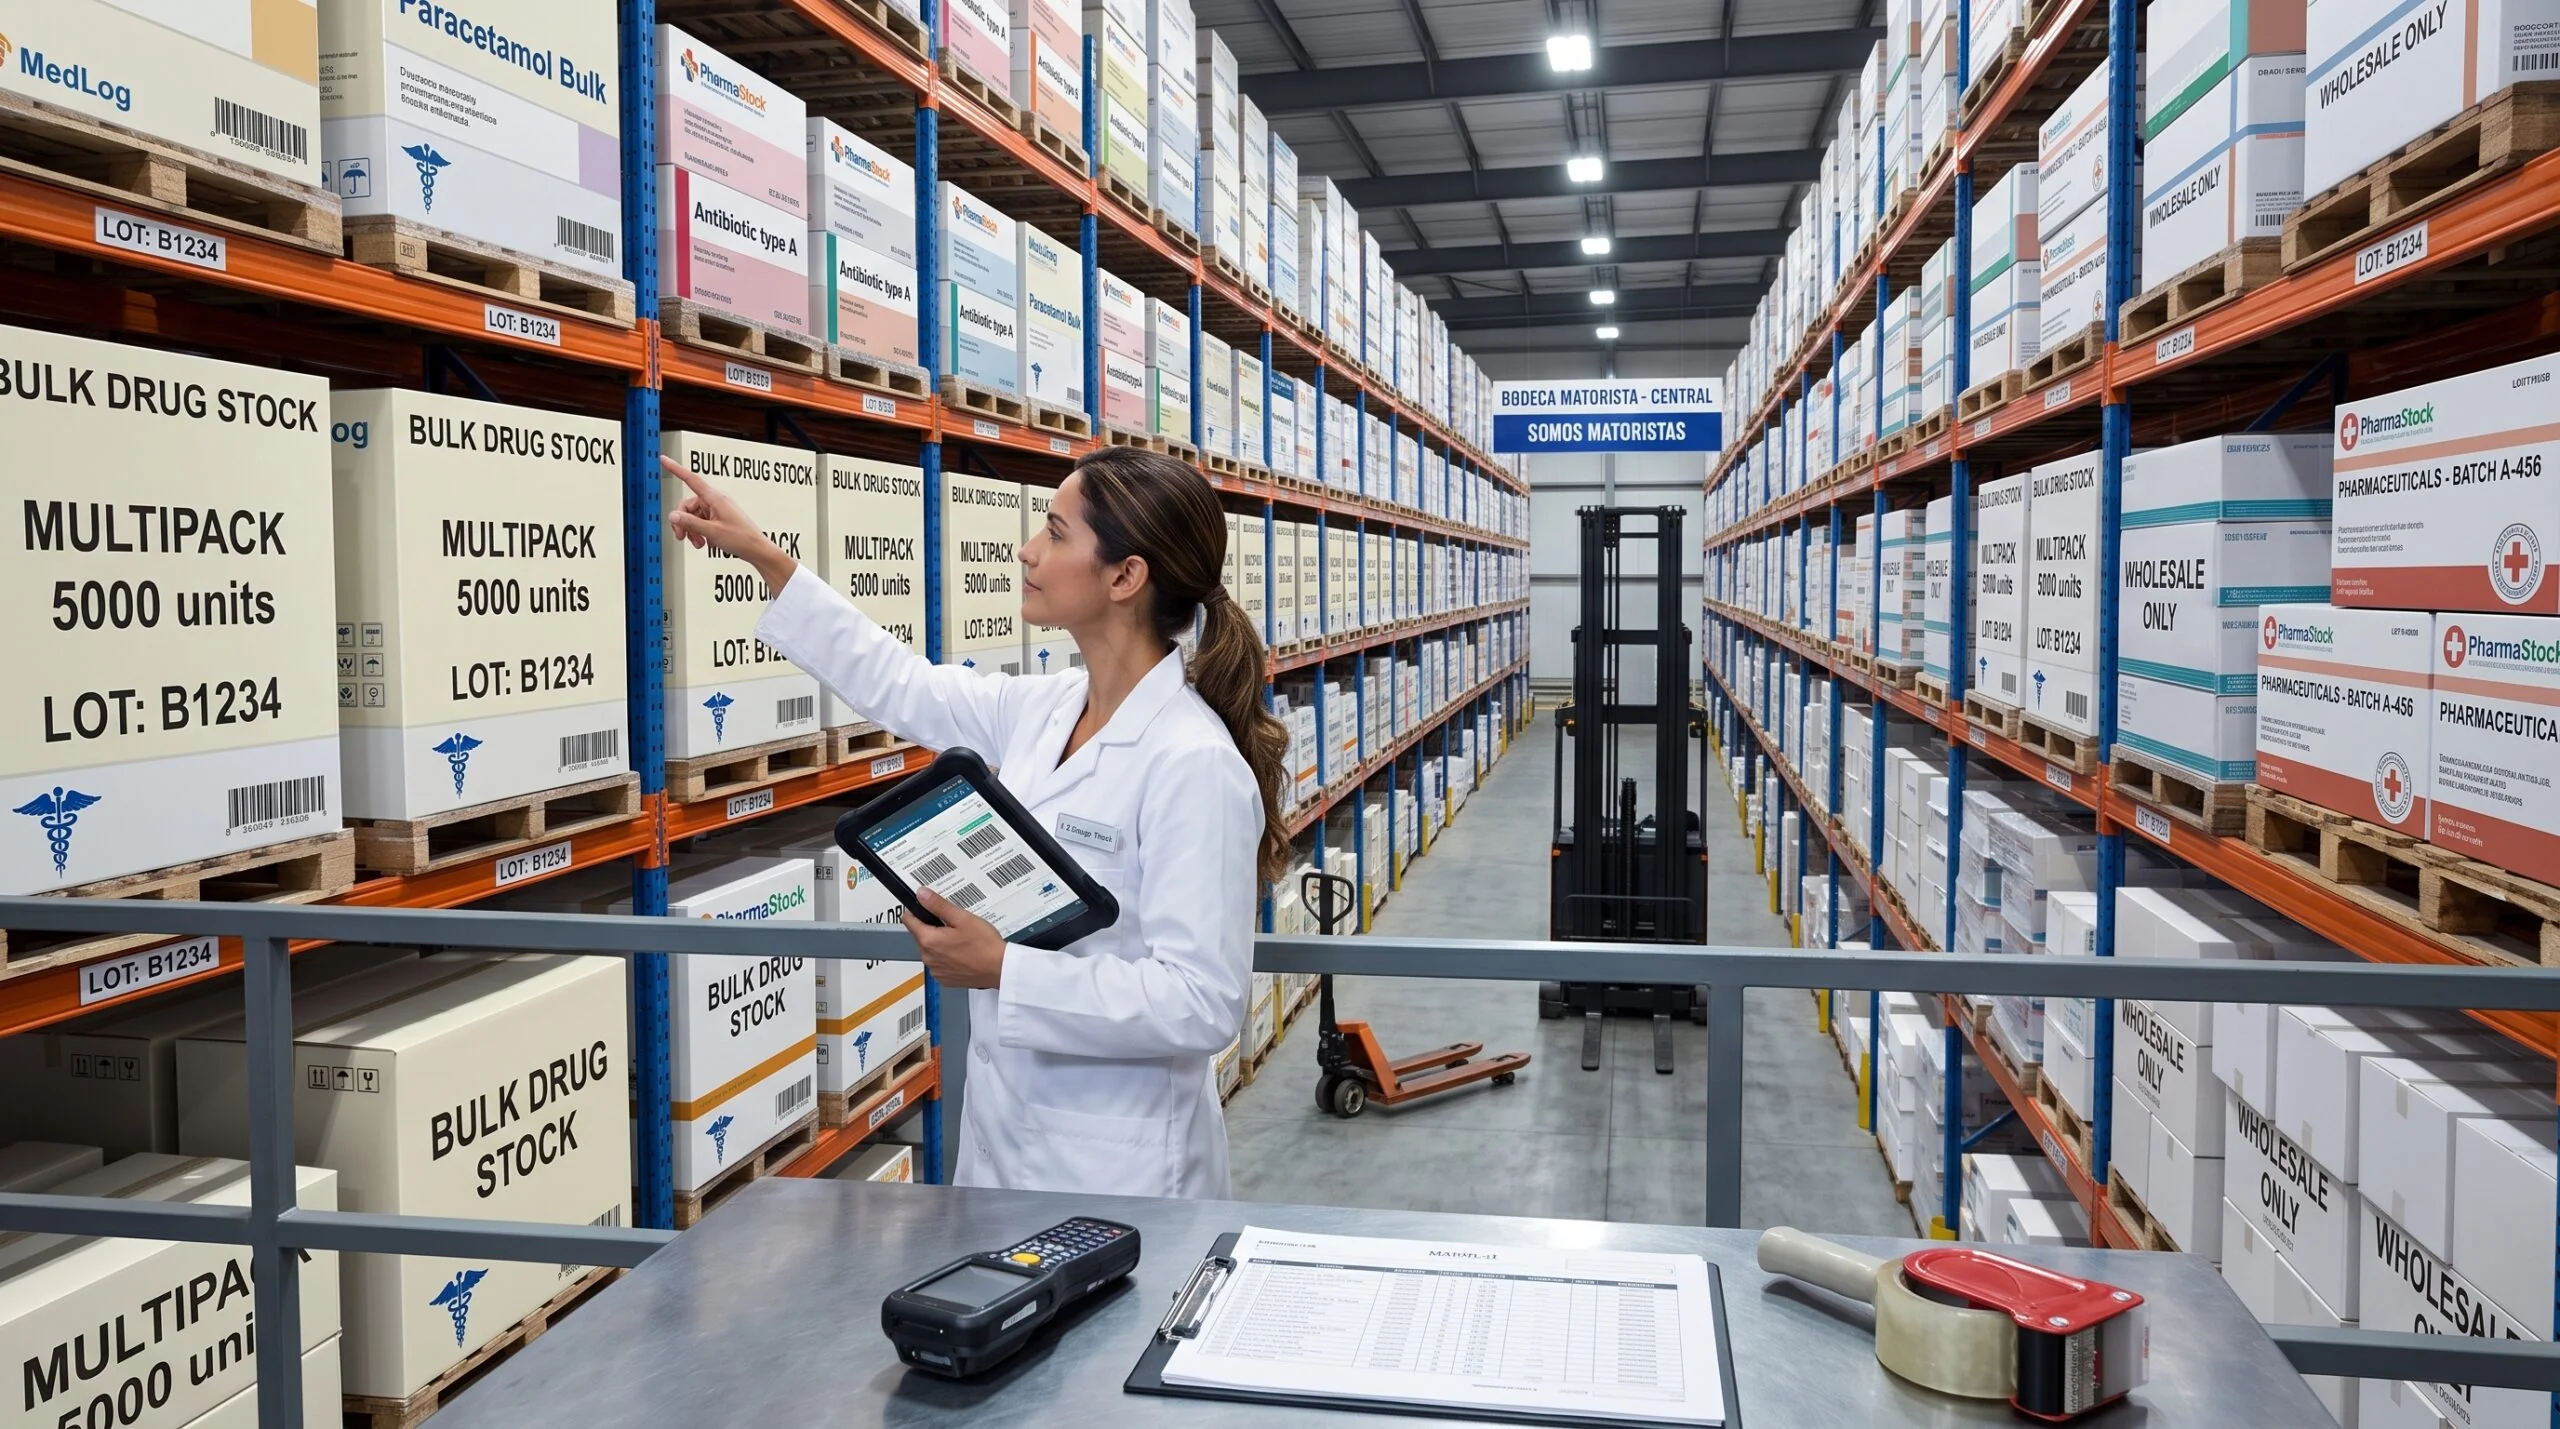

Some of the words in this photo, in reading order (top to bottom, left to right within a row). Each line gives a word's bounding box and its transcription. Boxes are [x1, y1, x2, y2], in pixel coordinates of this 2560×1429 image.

[2320, 32, 2401, 110] WHOLESALE
[2405, 0, 2448, 51] ONLY
[20, 47, 132, 111] MedLog
[560, 57, 607, 104] Bulk
[700, 61, 768, 112] PharmaStock
[2149, 181, 2197, 229] WHOLESALE
[2198, 164, 2222, 196] ONLY
[102, 216, 151, 248] LOT:
[157, 229, 219, 263] B1234
[694, 202, 757, 242] Antibiotic
[760, 230, 786, 252] type
[788, 238, 798, 256] A
[2359, 248, 2383, 276] LOT:
[2386, 230, 2423, 265] B1234
[839, 260, 883, 292] Antibiotic
[885, 280, 903, 300] type
[904, 286, 911, 302] A
[489, 310, 517, 332] LOT:
[521, 317, 556, 339] B1234
[960, 305, 993, 330] Antibiotic
[1008, 324, 1014, 338] A
[107, 372, 207, 418] DRUG
[217, 388, 318, 433] STOCK
[1561, 388, 1638, 406] MATORISTA
[1651, 388, 1713, 404] CENTRAL
[409, 414, 477, 451] BULK
[483, 424, 544, 459] DRUG
[550, 432, 616, 465] STOCK
[1528, 422, 1582, 442] SOMOS
[1588, 421, 1686, 441] MATORISTAS
[2361, 402, 2434, 436] PharmaStock
[690, 450, 730, 477] BULK
[734, 457, 770, 482] DRUG
[773, 462, 813, 486] STOCK
[832, 470, 861, 491] BULK
[863, 475, 890, 495] DRUG
[892, 479, 921, 497] STOCK
[2034, 478, 2050, 499] BULK
[2069, 467, 2094, 491] STOCK
[2338, 468, 2442, 498] PHARMACEUTICALS
[2453, 460, 2496, 486] BATCH
[2500, 454, 2541, 480] A-456
[952, 486, 974, 504] BULK
[24, 499, 286, 556] MULTIPACK
[442, 519, 596, 559] MULTIPACK
[845, 535, 914, 560] MULTIPACK
[2036, 534, 2087, 561] MULTIPACK
[961, 541, 1013, 563] MULTIPACK
[715, 574, 754, 602] 5000
[851, 573, 878, 597] 5000
[882, 573, 911, 596] units
[965, 573, 987, 594] 5000
[989, 572, 1011, 593] units
[2037, 573, 2057, 597] 5000
[2058, 573, 2082, 598] units
[2125, 559, 2205, 589] WHOLESALE
[53, 579, 160, 631] 5000
[177, 580, 275, 627] units
[457, 577, 521, 617] 5000
[529, 576, 590, 614] units
[2143, 602, 2177, 631] ONLY
[882, 623, 913, 645] 1234
[964, 619, 985, 640] LOT:
[987, 616, 1012, 638] B1234
[2054, 629, 2080, 654] B1234
[2278, 623, 2333, 644] PharmaStock
[2469, 635, 2560, 663] PharmaStock
[713, 638, 749, 667] LOT:
[754, 638, 788, 663] B12
[451, 662, 512, 701] LOT:
[521, 653, 594, 693] B1234
[2262, 675, 2340, 704] PHARMACEUTICALS
[2347, 688, 2380, 711] BATCH
[2383, 694, 2413, 717] A-456
[44, 688, 146, 743] LOT:
[161, 676, 282, 731] B1234
[2440, 702, 2560, 743] PHARMACEUTICA
[500, 857, 528, 880] LOT:
[90, 962, 139, 994] LOT:
[149, 942, 212, 978] B1234
[708, 965, 754, 1012] BULK
[759, 957, 803, 987] DRUG
[730, 988, 785, 1037] STOCK
[2122, 999, 2184, 1073] WHOLESALE
[2137, 1048, 2164, 1094] ONLY
[431, 1079, 520, 1161] BULK
[529, 1040, 608, 1113] DRUG
[476, 1109, 578, 1198] STOCK
[2238, 1101, 2328, 1213] WHOLESALE
[2261, 1172, 2300, 1235] ONLY
[2376, 1215, 2521, 1341] WHOLESAL
[23, 1248, 312, 1412] MULTIPA
[190, 1311, 255, 1386] uni
